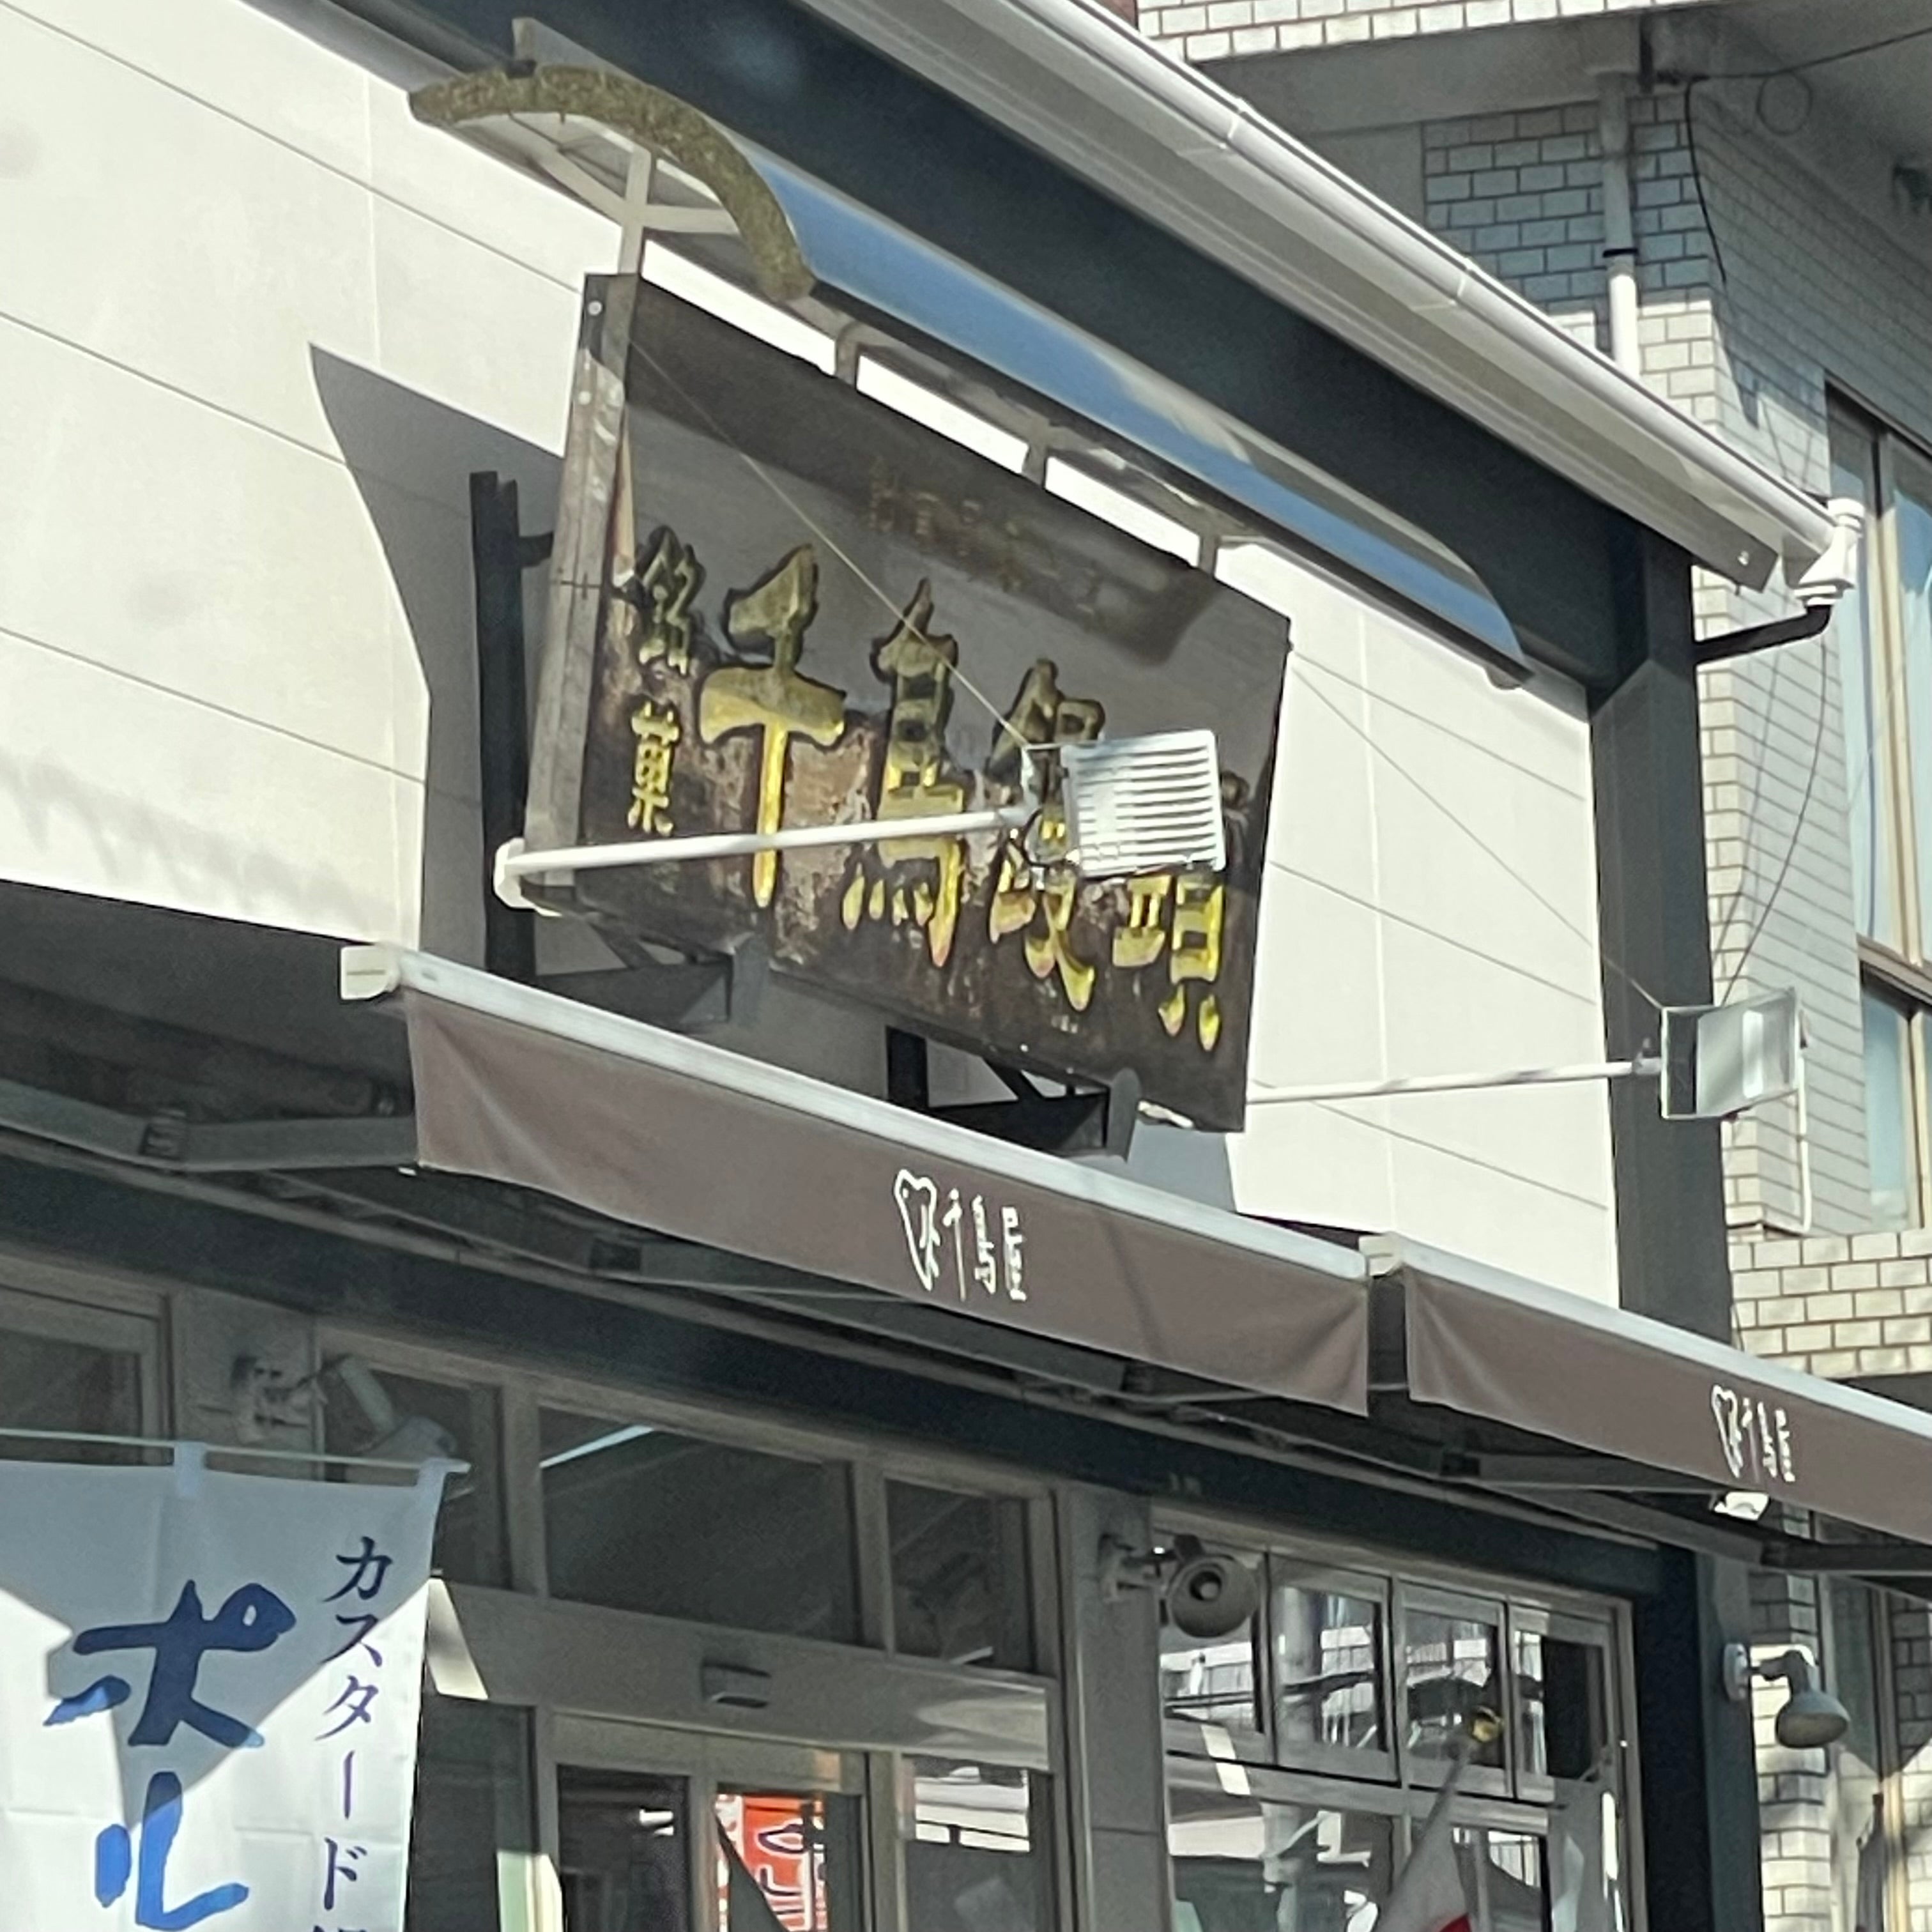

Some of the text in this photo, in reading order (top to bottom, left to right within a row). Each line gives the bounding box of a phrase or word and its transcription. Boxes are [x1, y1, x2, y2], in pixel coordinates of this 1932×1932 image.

[315, 1536, 393, 1932] カスタード
